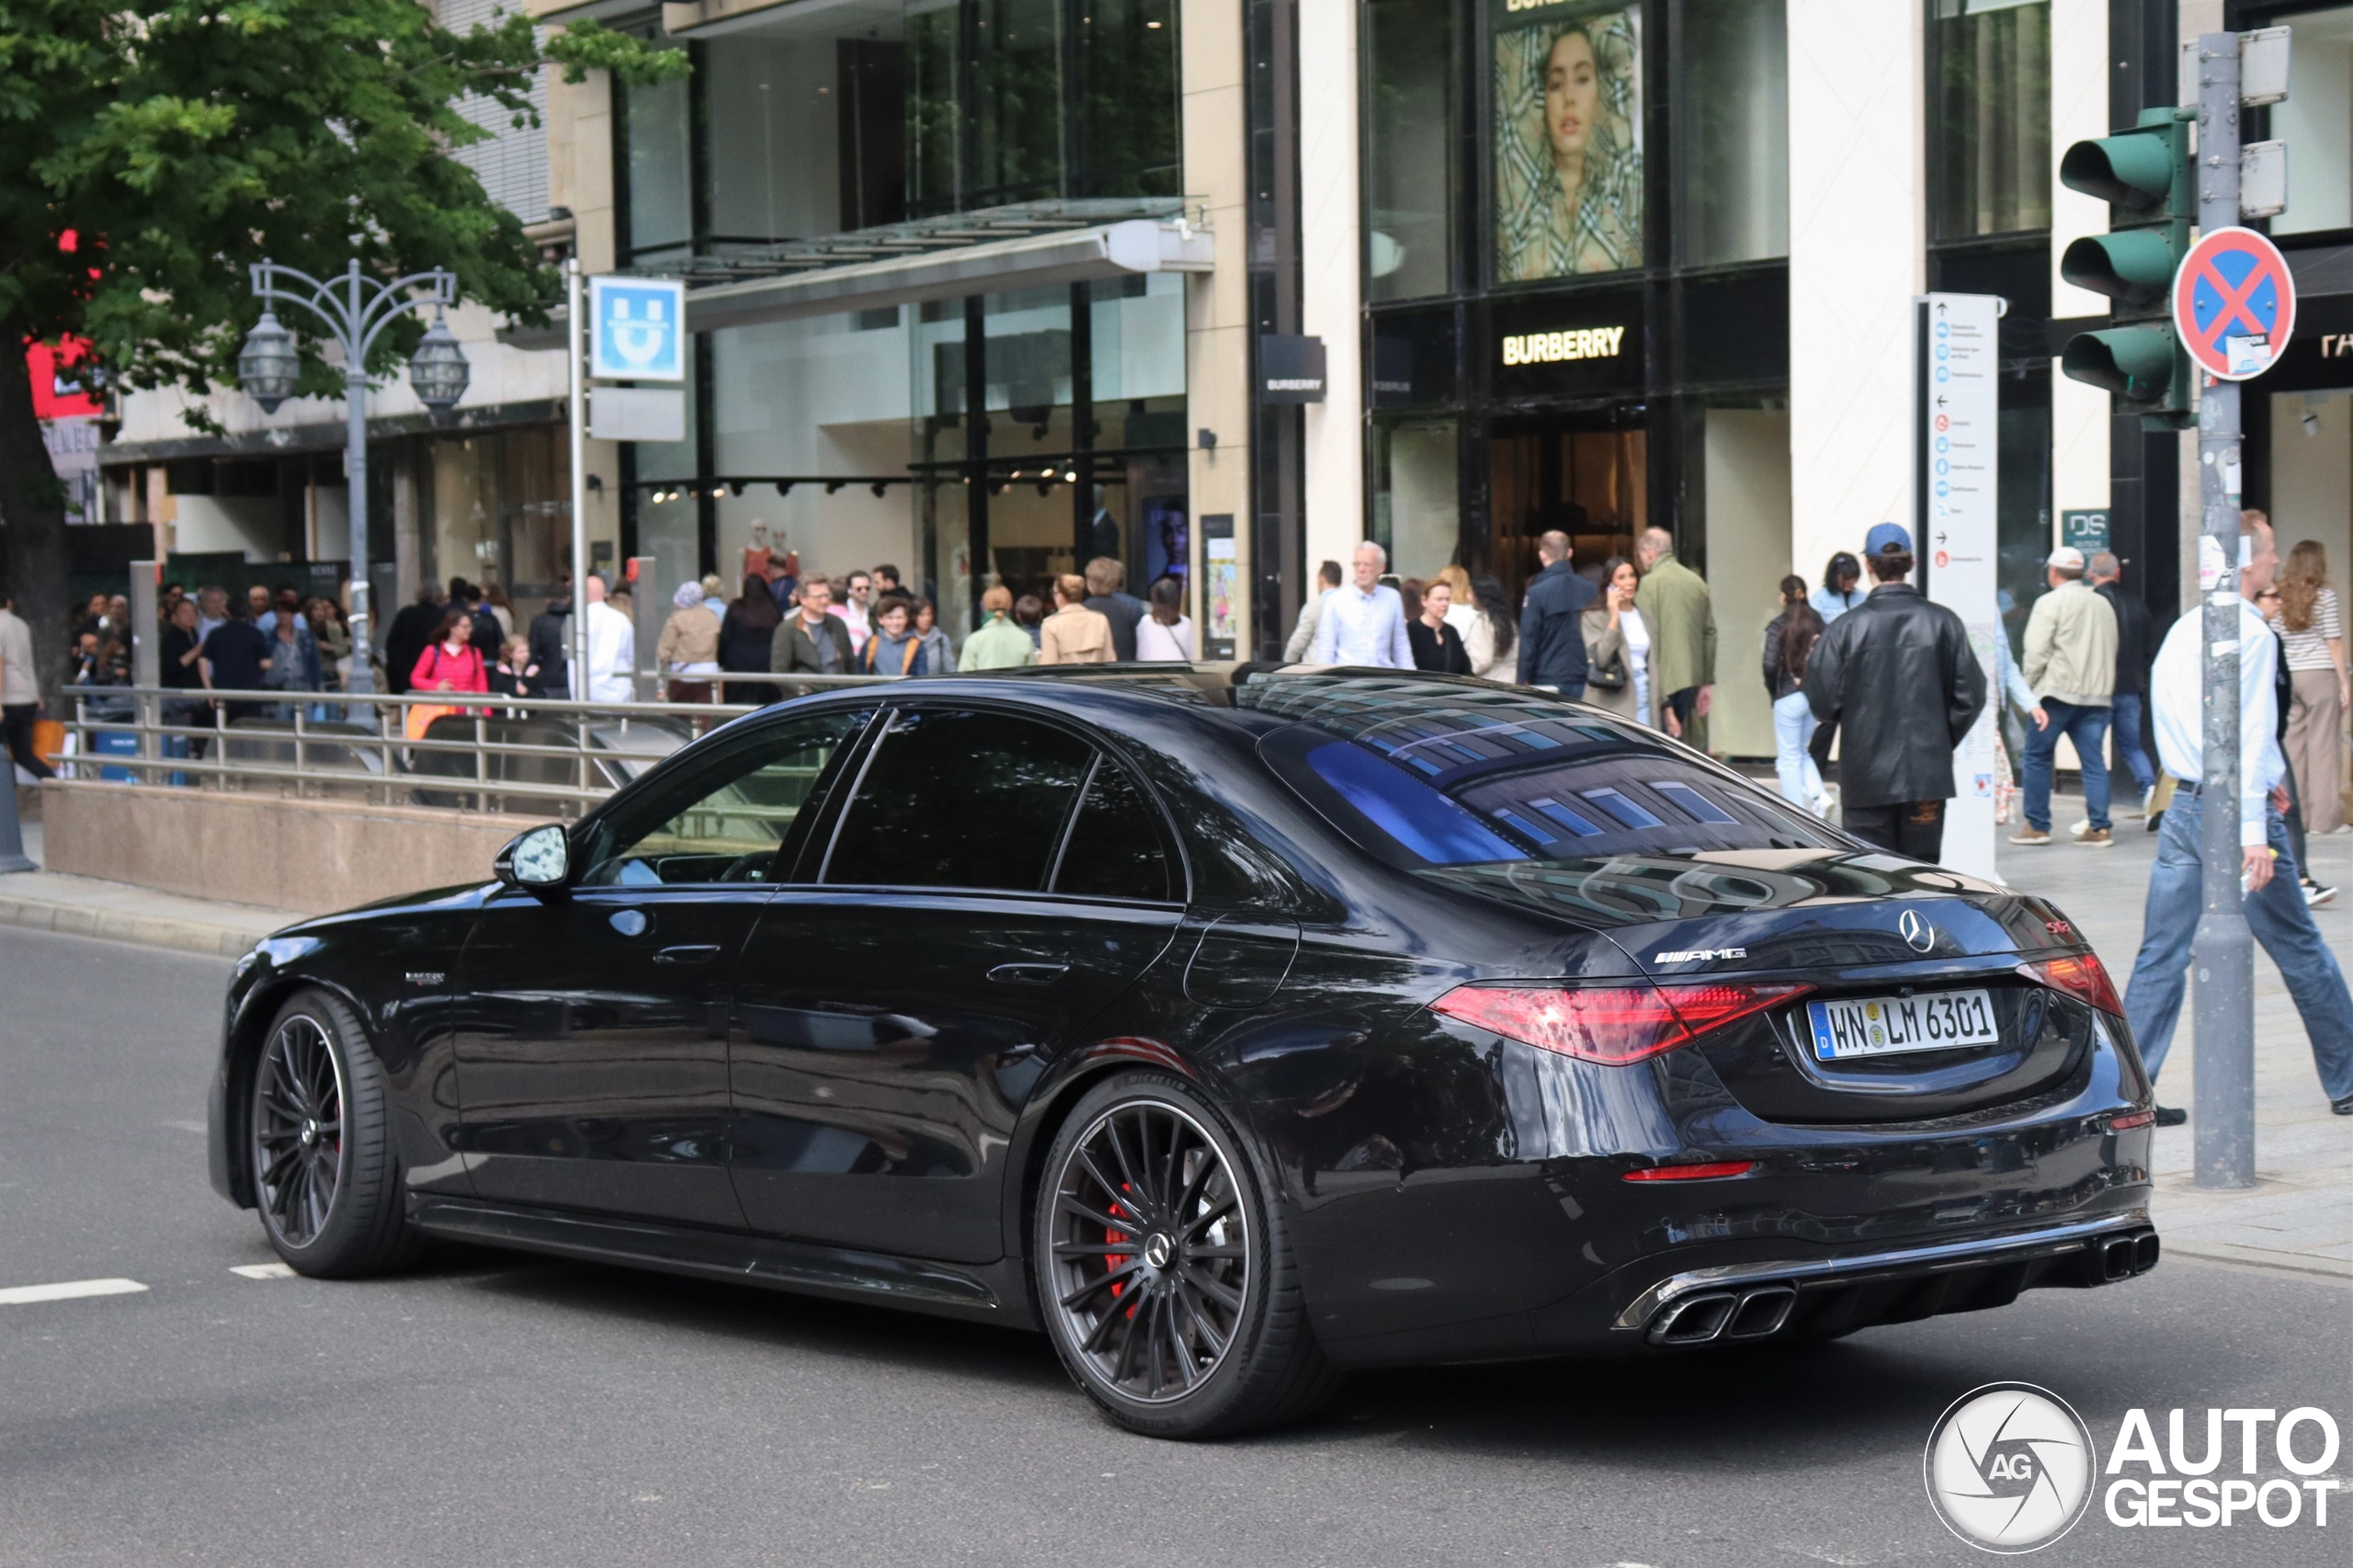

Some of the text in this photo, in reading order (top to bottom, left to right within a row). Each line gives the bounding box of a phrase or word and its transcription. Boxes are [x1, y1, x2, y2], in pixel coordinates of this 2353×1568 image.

[1503, 326, 1624, 365] BURBERRY
[1267, 379, 1322, 391] BURBERRY
[2070, 515, 2106, 536] DS
[1684, 948, 1747, 962] AMG
[1820, 996, 1992, 1049] D WN LM 6301
[1128, 1074, 1187, 1092] MICHELIN
